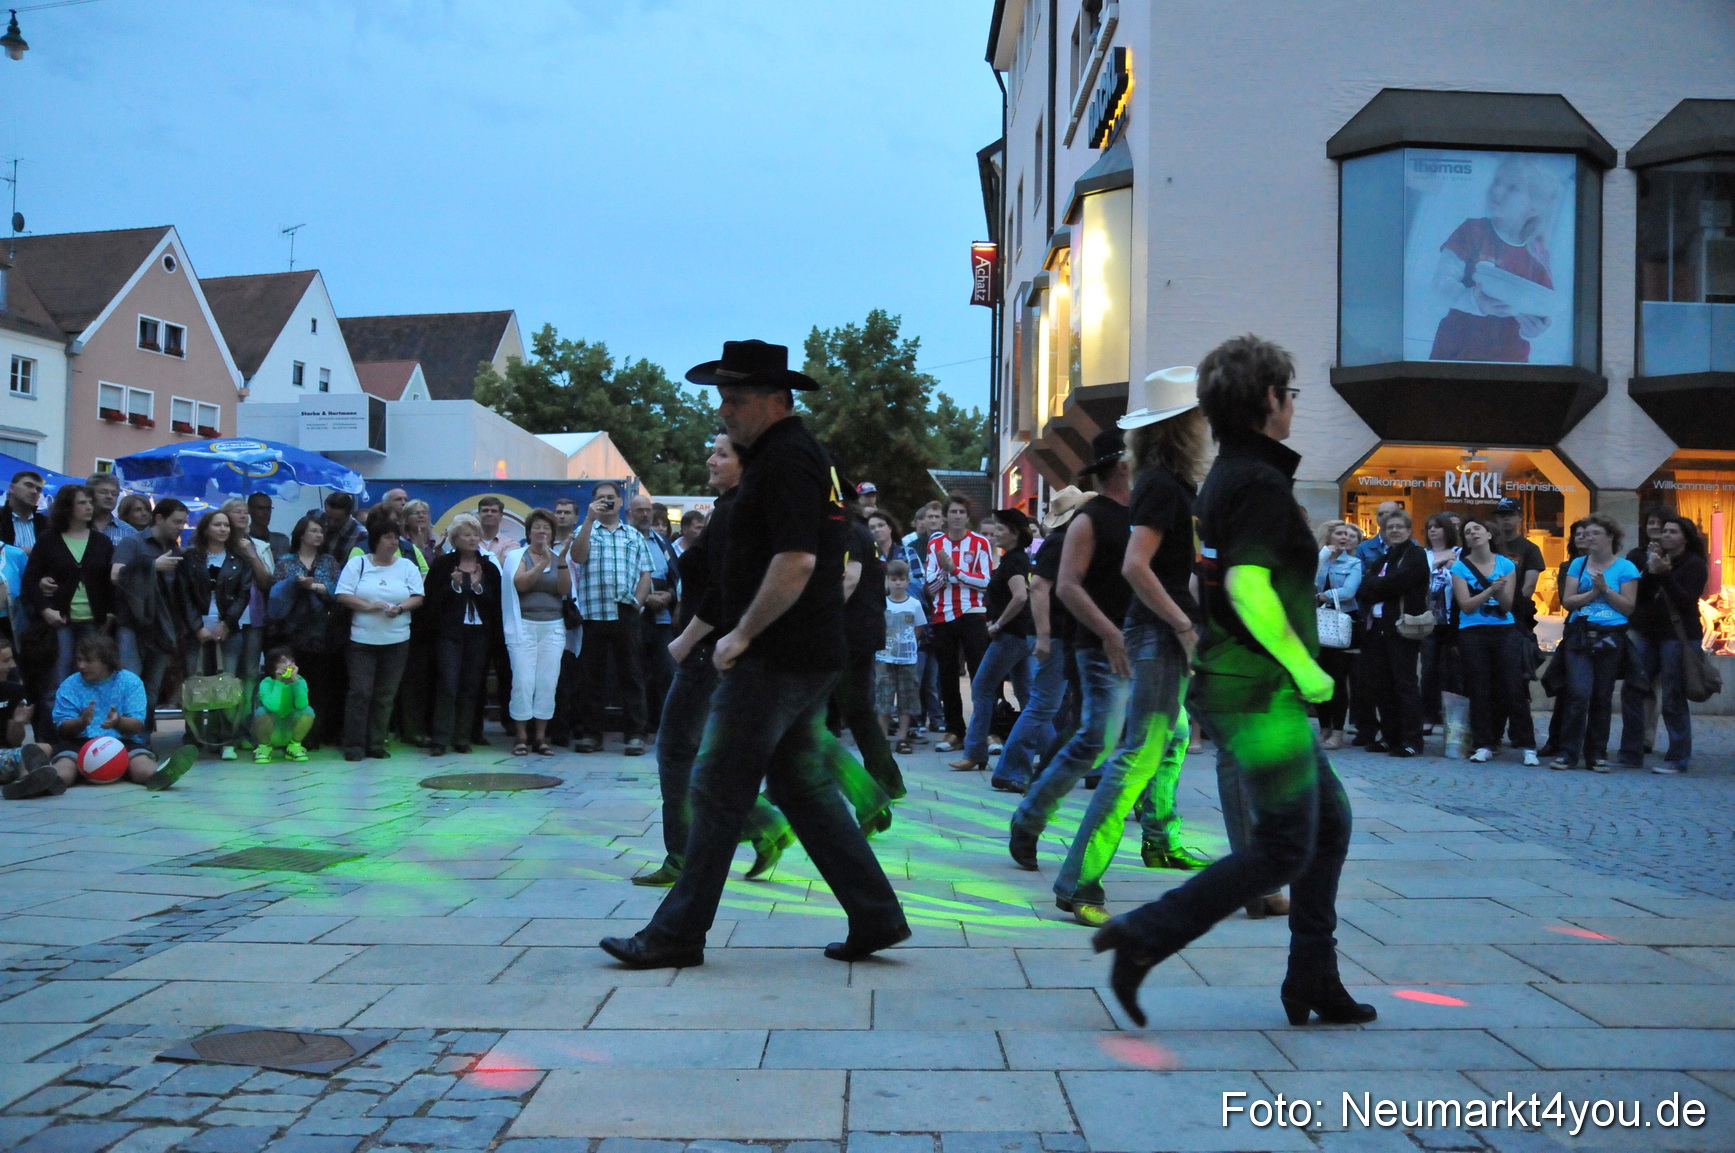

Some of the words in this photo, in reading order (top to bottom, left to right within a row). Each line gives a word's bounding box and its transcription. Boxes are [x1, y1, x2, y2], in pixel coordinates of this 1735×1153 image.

[1409, 158, 1473, 175] Thomas
[975, 255, 991, 301] Achatz
[1358, 476, 1425, 487] Willkommen
[1428, 478, 1441, 488] im
[1444, 470, 1502, 499] RACKL
[1653, 481, 1719, 490] Willkommen
